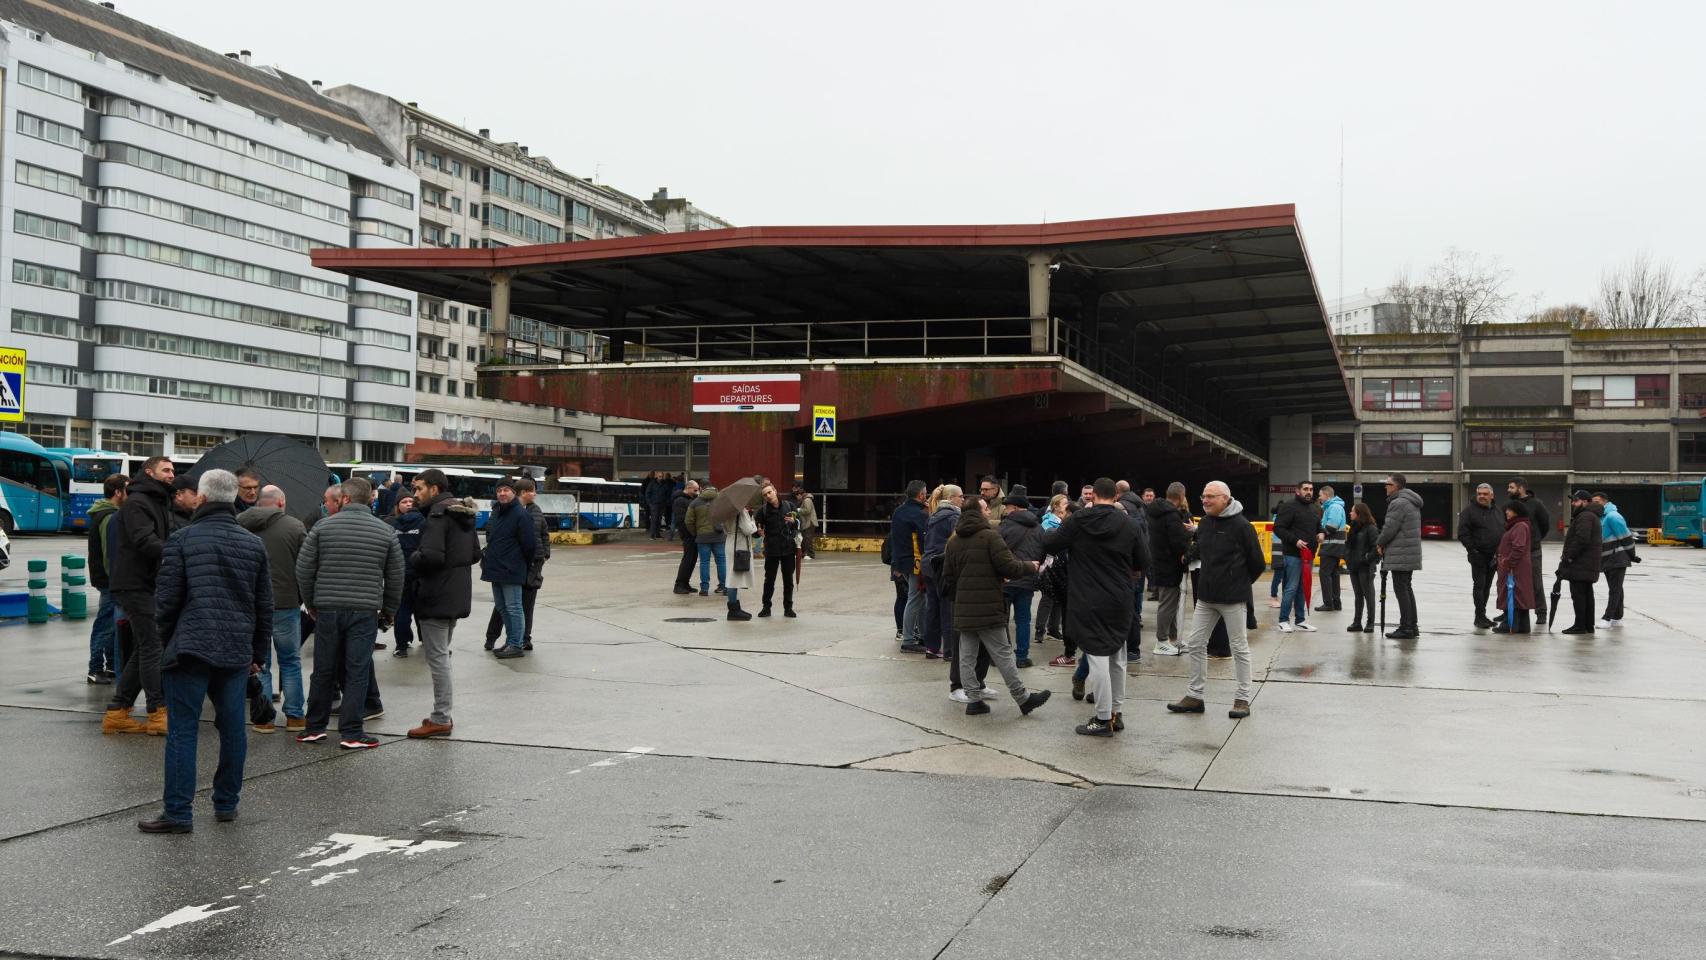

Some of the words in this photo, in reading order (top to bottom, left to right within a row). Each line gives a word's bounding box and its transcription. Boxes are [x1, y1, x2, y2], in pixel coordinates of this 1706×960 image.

[732, 384, 761, 393] SAÍDAS
[720, 395, 772, 403] DEPARTURES
[1035, 394, 1047, 408] 20
